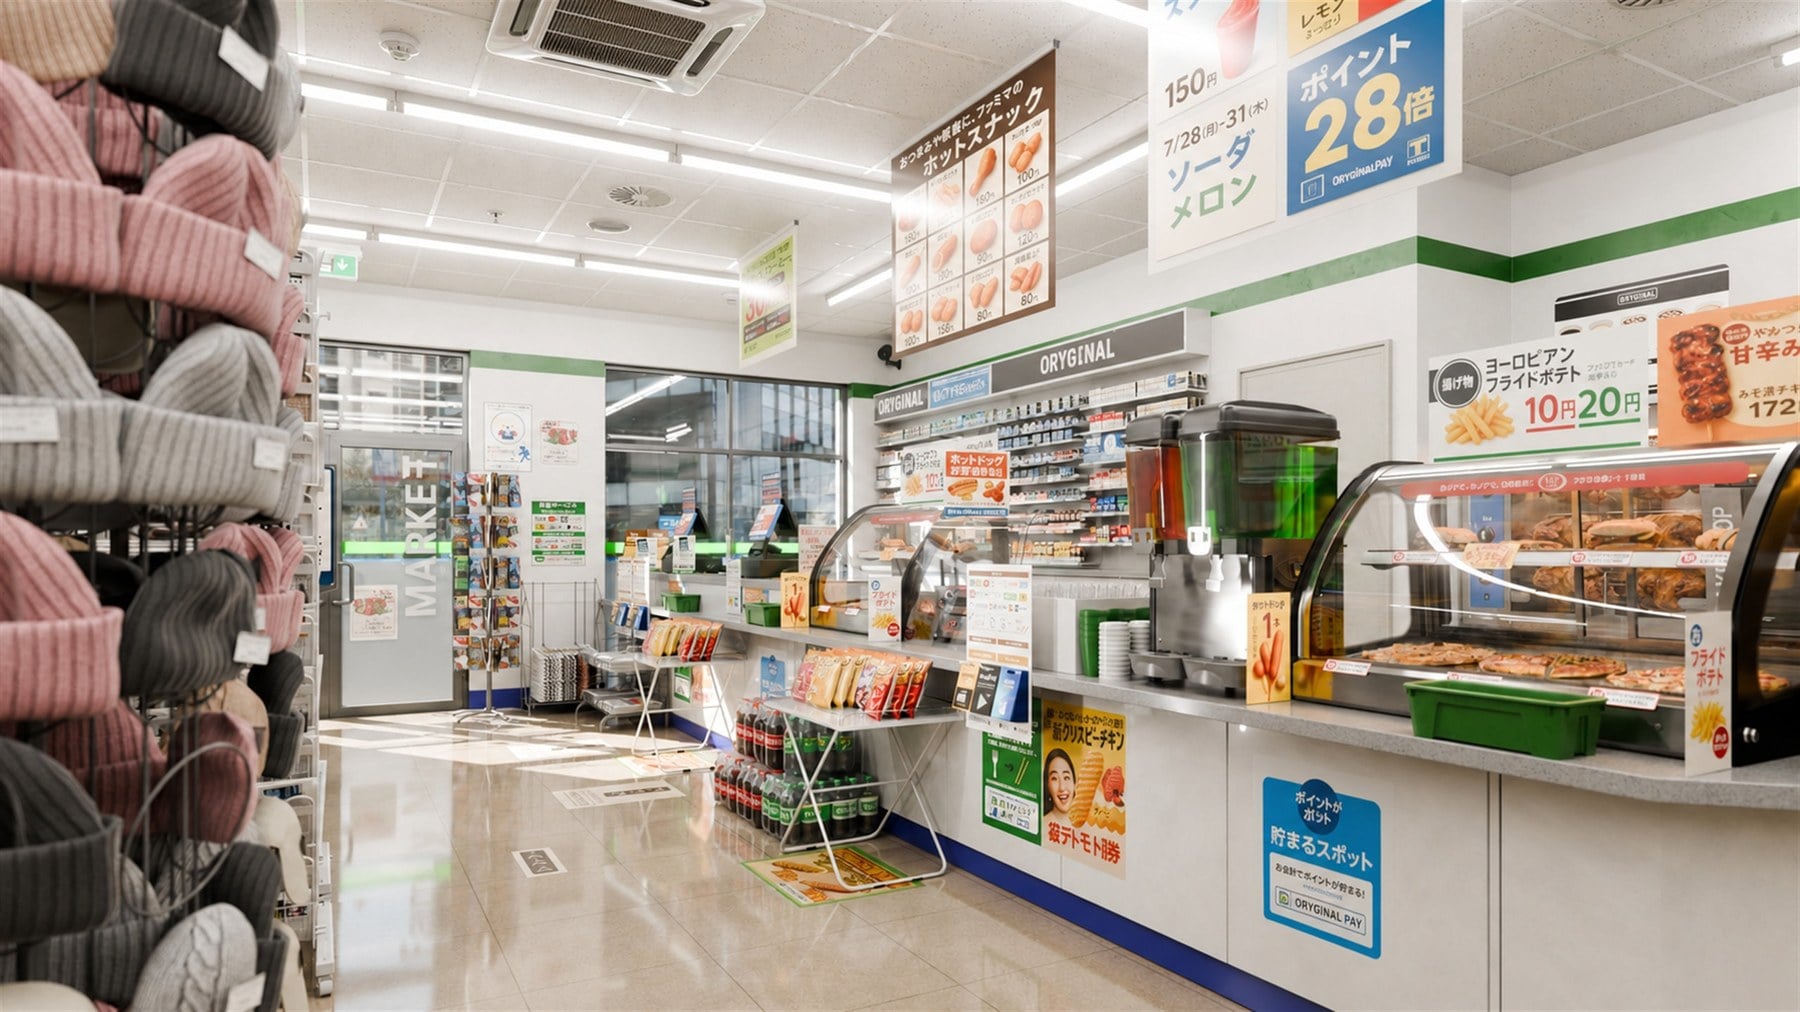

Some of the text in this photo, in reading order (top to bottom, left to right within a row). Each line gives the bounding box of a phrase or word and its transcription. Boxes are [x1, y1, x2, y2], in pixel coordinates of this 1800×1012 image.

[1164, 67, 1217, 108] 150円
[1300, 33, 1411, 102] ポイント
[923, 86, 1043, 176] ホットスナック
[1304, 72, 1435, 174] 28倍
[1168, 128, 1256, 192] ソーダ
[1170, 174, 1257, 229] メロン
[1040, 338, 1115, 375] ORYGINAL
[1486, 347, 1575, 375] ヨーロピアン
[878, 390, 924, 415] ORYGINAL
[1525, 386, 1641, 424] 10円 20円
[402, 455, 437, 617] MARKET
[1691, 647, 1726, 667] フライド
[1295, 791, 1343, 814] ポイントが
[1270, 825, 1374, 872] 貯まるスポット
[1295, 897, 1363, 929] ORYGINAL PAY
